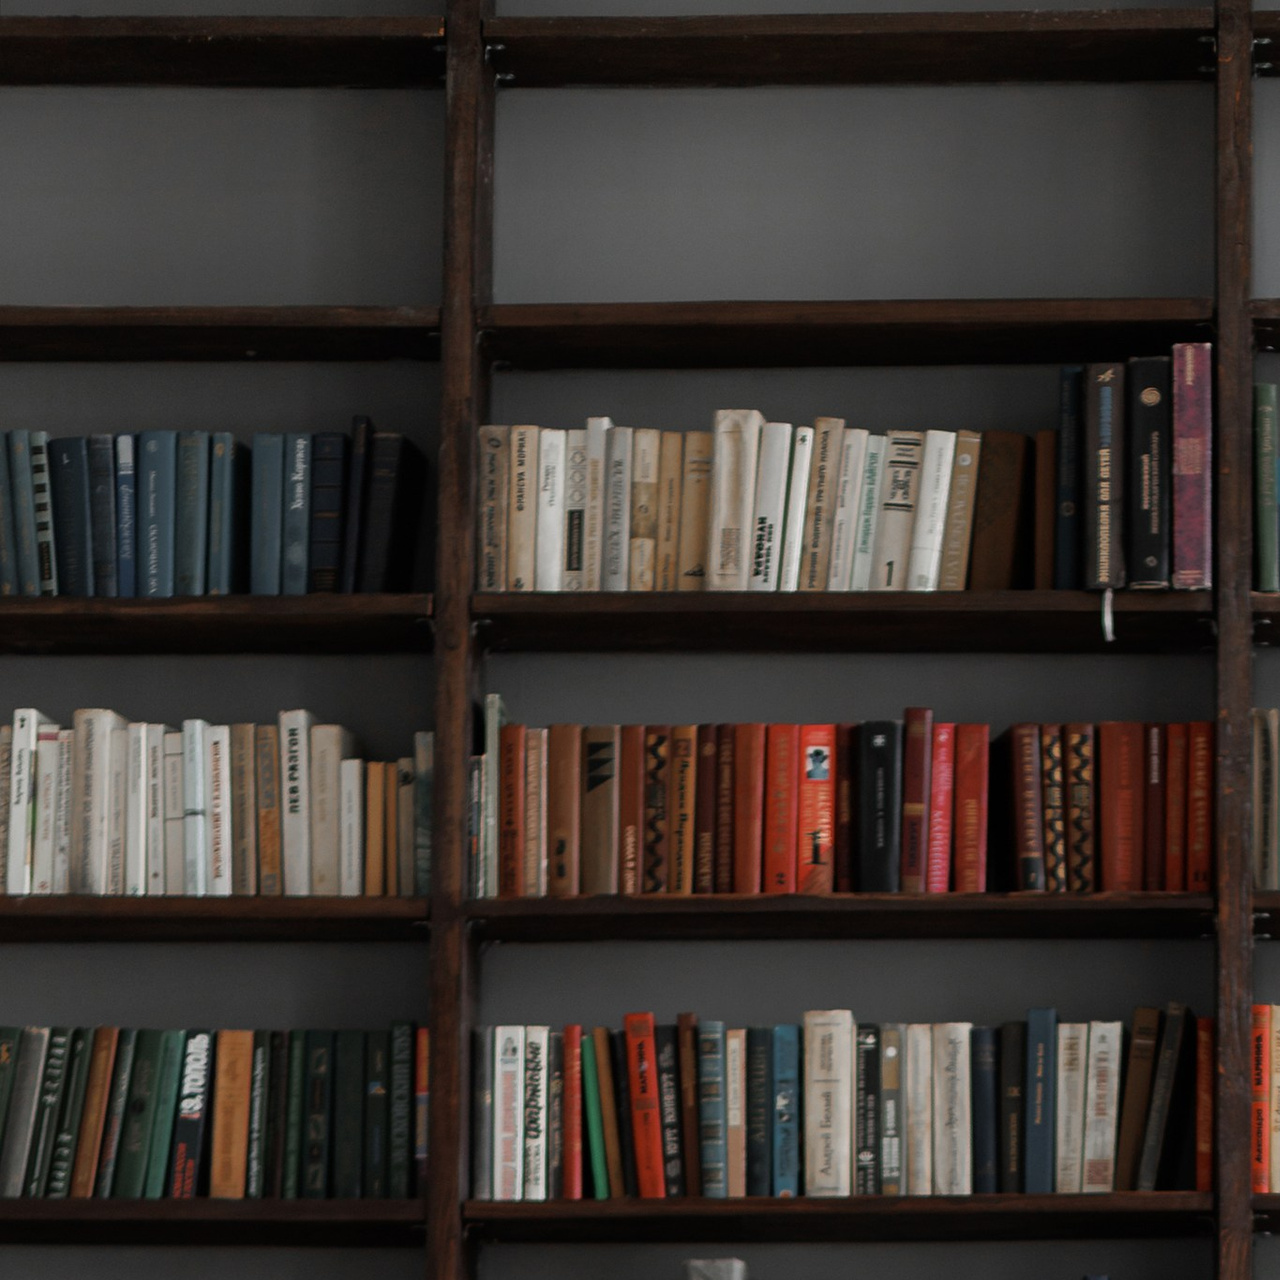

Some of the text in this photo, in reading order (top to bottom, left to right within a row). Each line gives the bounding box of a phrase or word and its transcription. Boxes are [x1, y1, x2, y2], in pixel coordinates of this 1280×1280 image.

[288, 727, 300, 781] РАЗГОН
[181, 1033, 212, 1095] ТОПОЛЬ
[819, 1091, 832, 1176] Андрей Белый
